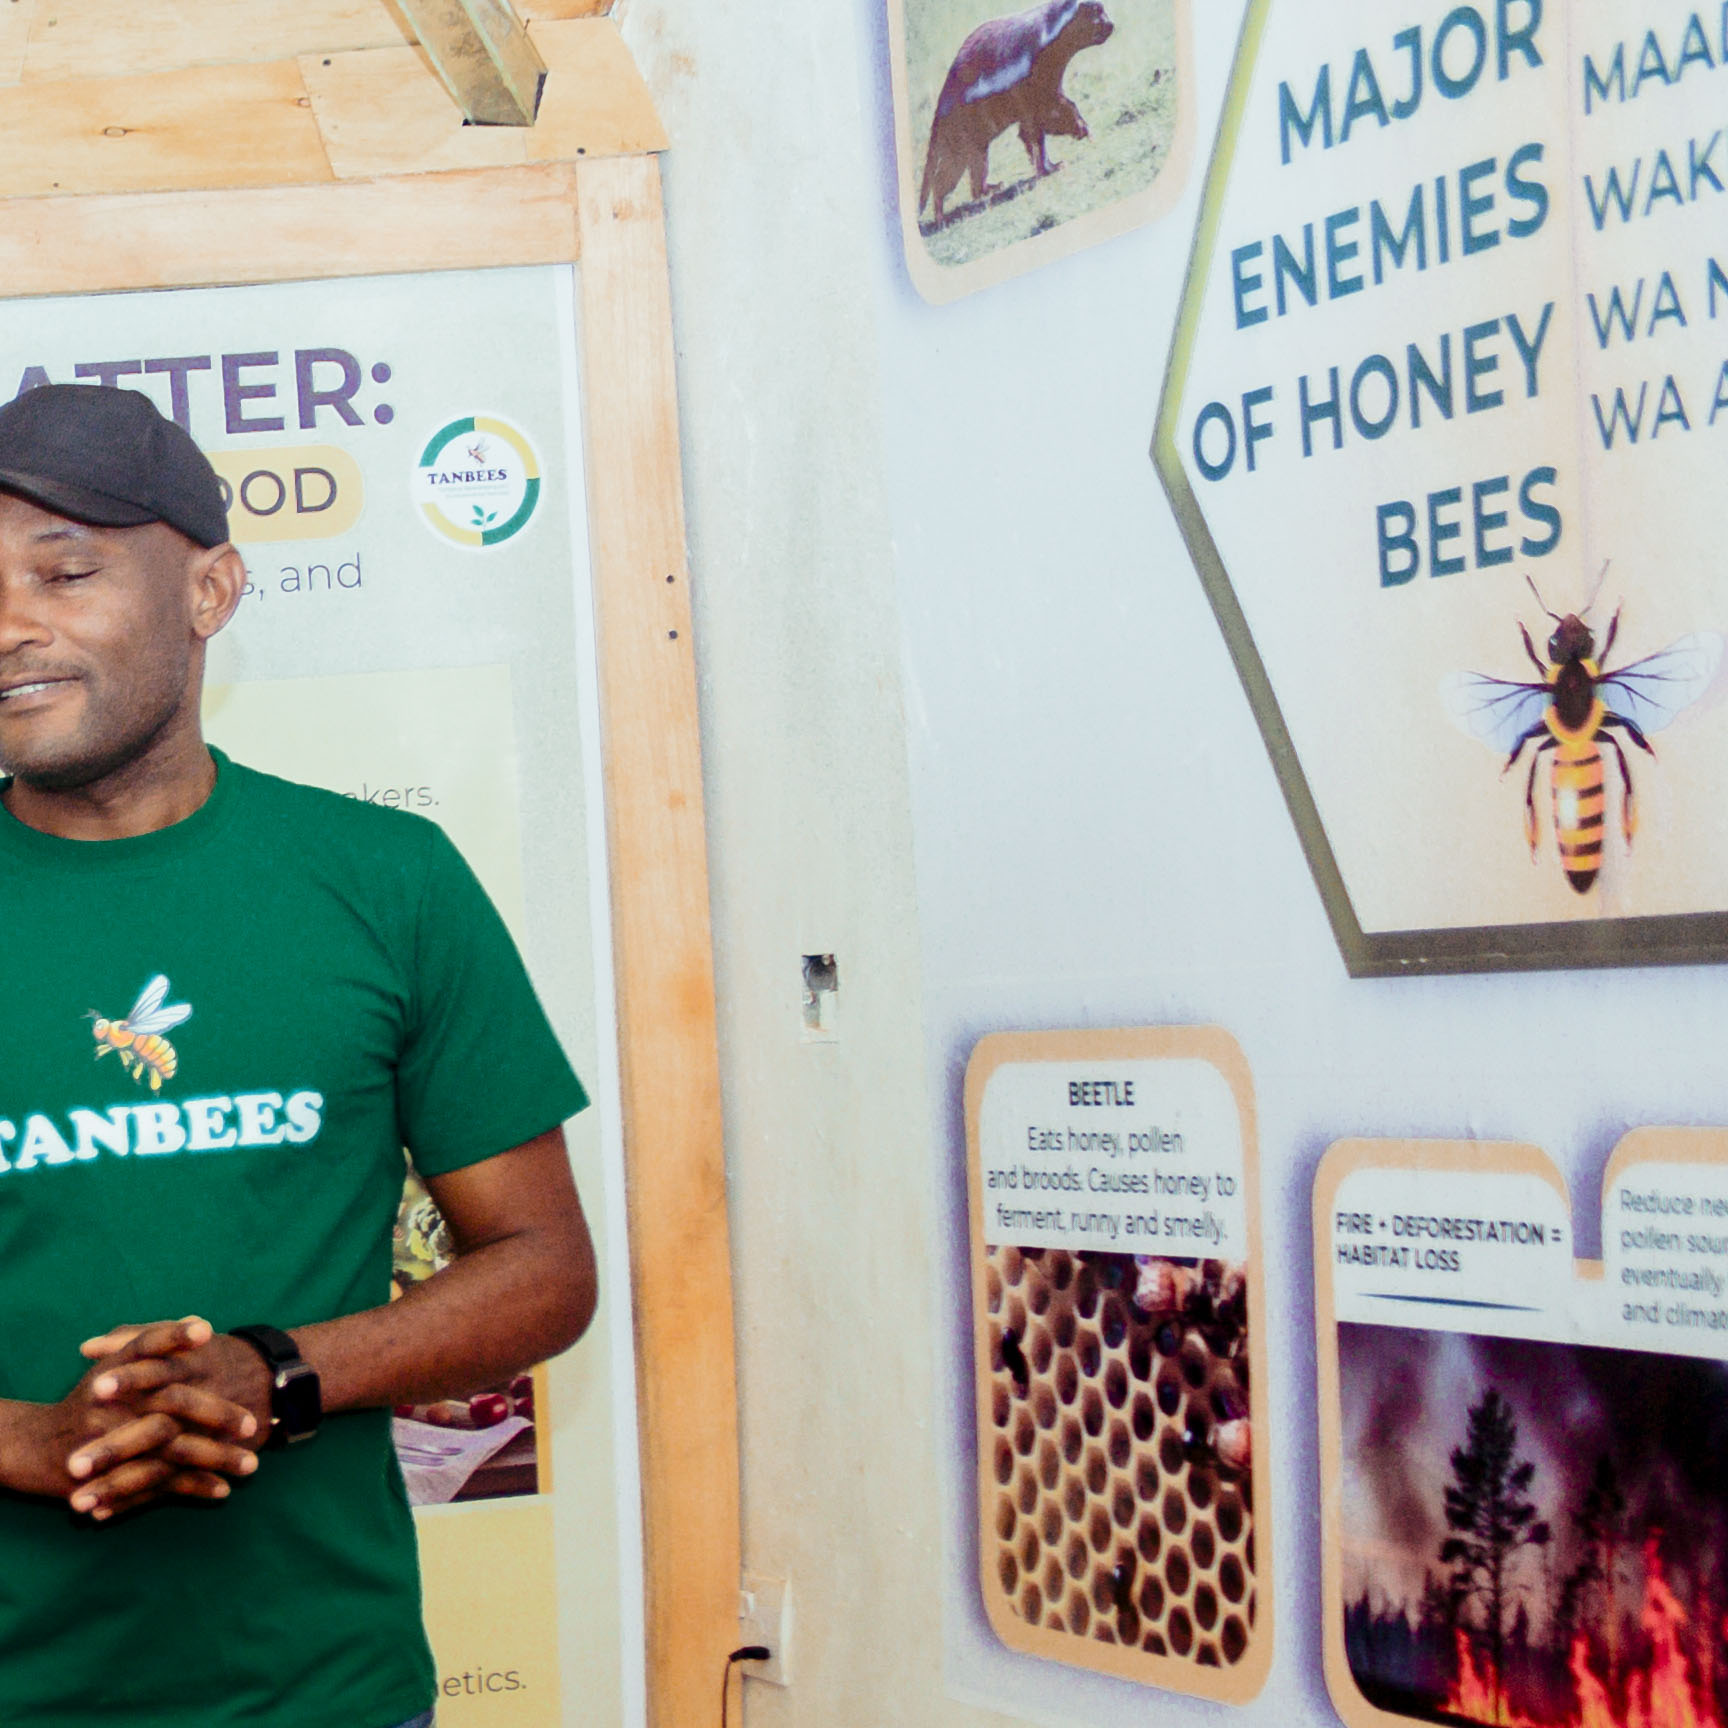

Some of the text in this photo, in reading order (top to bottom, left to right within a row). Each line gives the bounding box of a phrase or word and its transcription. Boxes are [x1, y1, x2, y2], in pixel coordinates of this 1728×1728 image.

[1582, 0, 1728, 117] MAA
[1278, 0, 1544, 166] MAJOR
[1583, 129, 1725, 232] WAK
[1230, 142, 1549, 331] ENEMIES
[1585, 270, 1688, 350] WA
[1191, 384, 1274, 483] OF
[1298, 301, 1556, 459] HONEY
[1590, 374, 1692, 451] WA
[426, 467, 508, 485] TANBEES
[1376, 465, 1564, 589] BEES
[279, 551, 363, 594] and
[1068, 1080, 1135, 1106] BEETLE
[1027, 1126, 1063, 1151] Eats
[1128, 1125, 1184, 1159] pollen
[987, 1164, 1017, 1189] and
[1087, 1167, 1149, 1193] Causes
[1154, 1167, 1211, 1203] honey
[1215, 1171, 1236, 1196] to
[1620, 1188, 1693, 1216] Reduce
[1071, 1212, 1120, 1240] runny
[1125, 1209, 1158, 1236] and
[1164, 1211, 1228, 1246] smelly.
[1336, 1212, 1373, 1235] FIRE
[1391, 1214, 1545, 1246] DEFORESTATION
[1551, 1228, 1564, 1242] =
[1621, 1226, 1681, 1253] pollen
[1336, 1244, 1461, 1273] HABITAT LOSS
[1621, 1265, 1724, 1298] eventually
[1622, 1300, 1728, 1330] and climat
[442, 1666, 527, 1697] etics.
